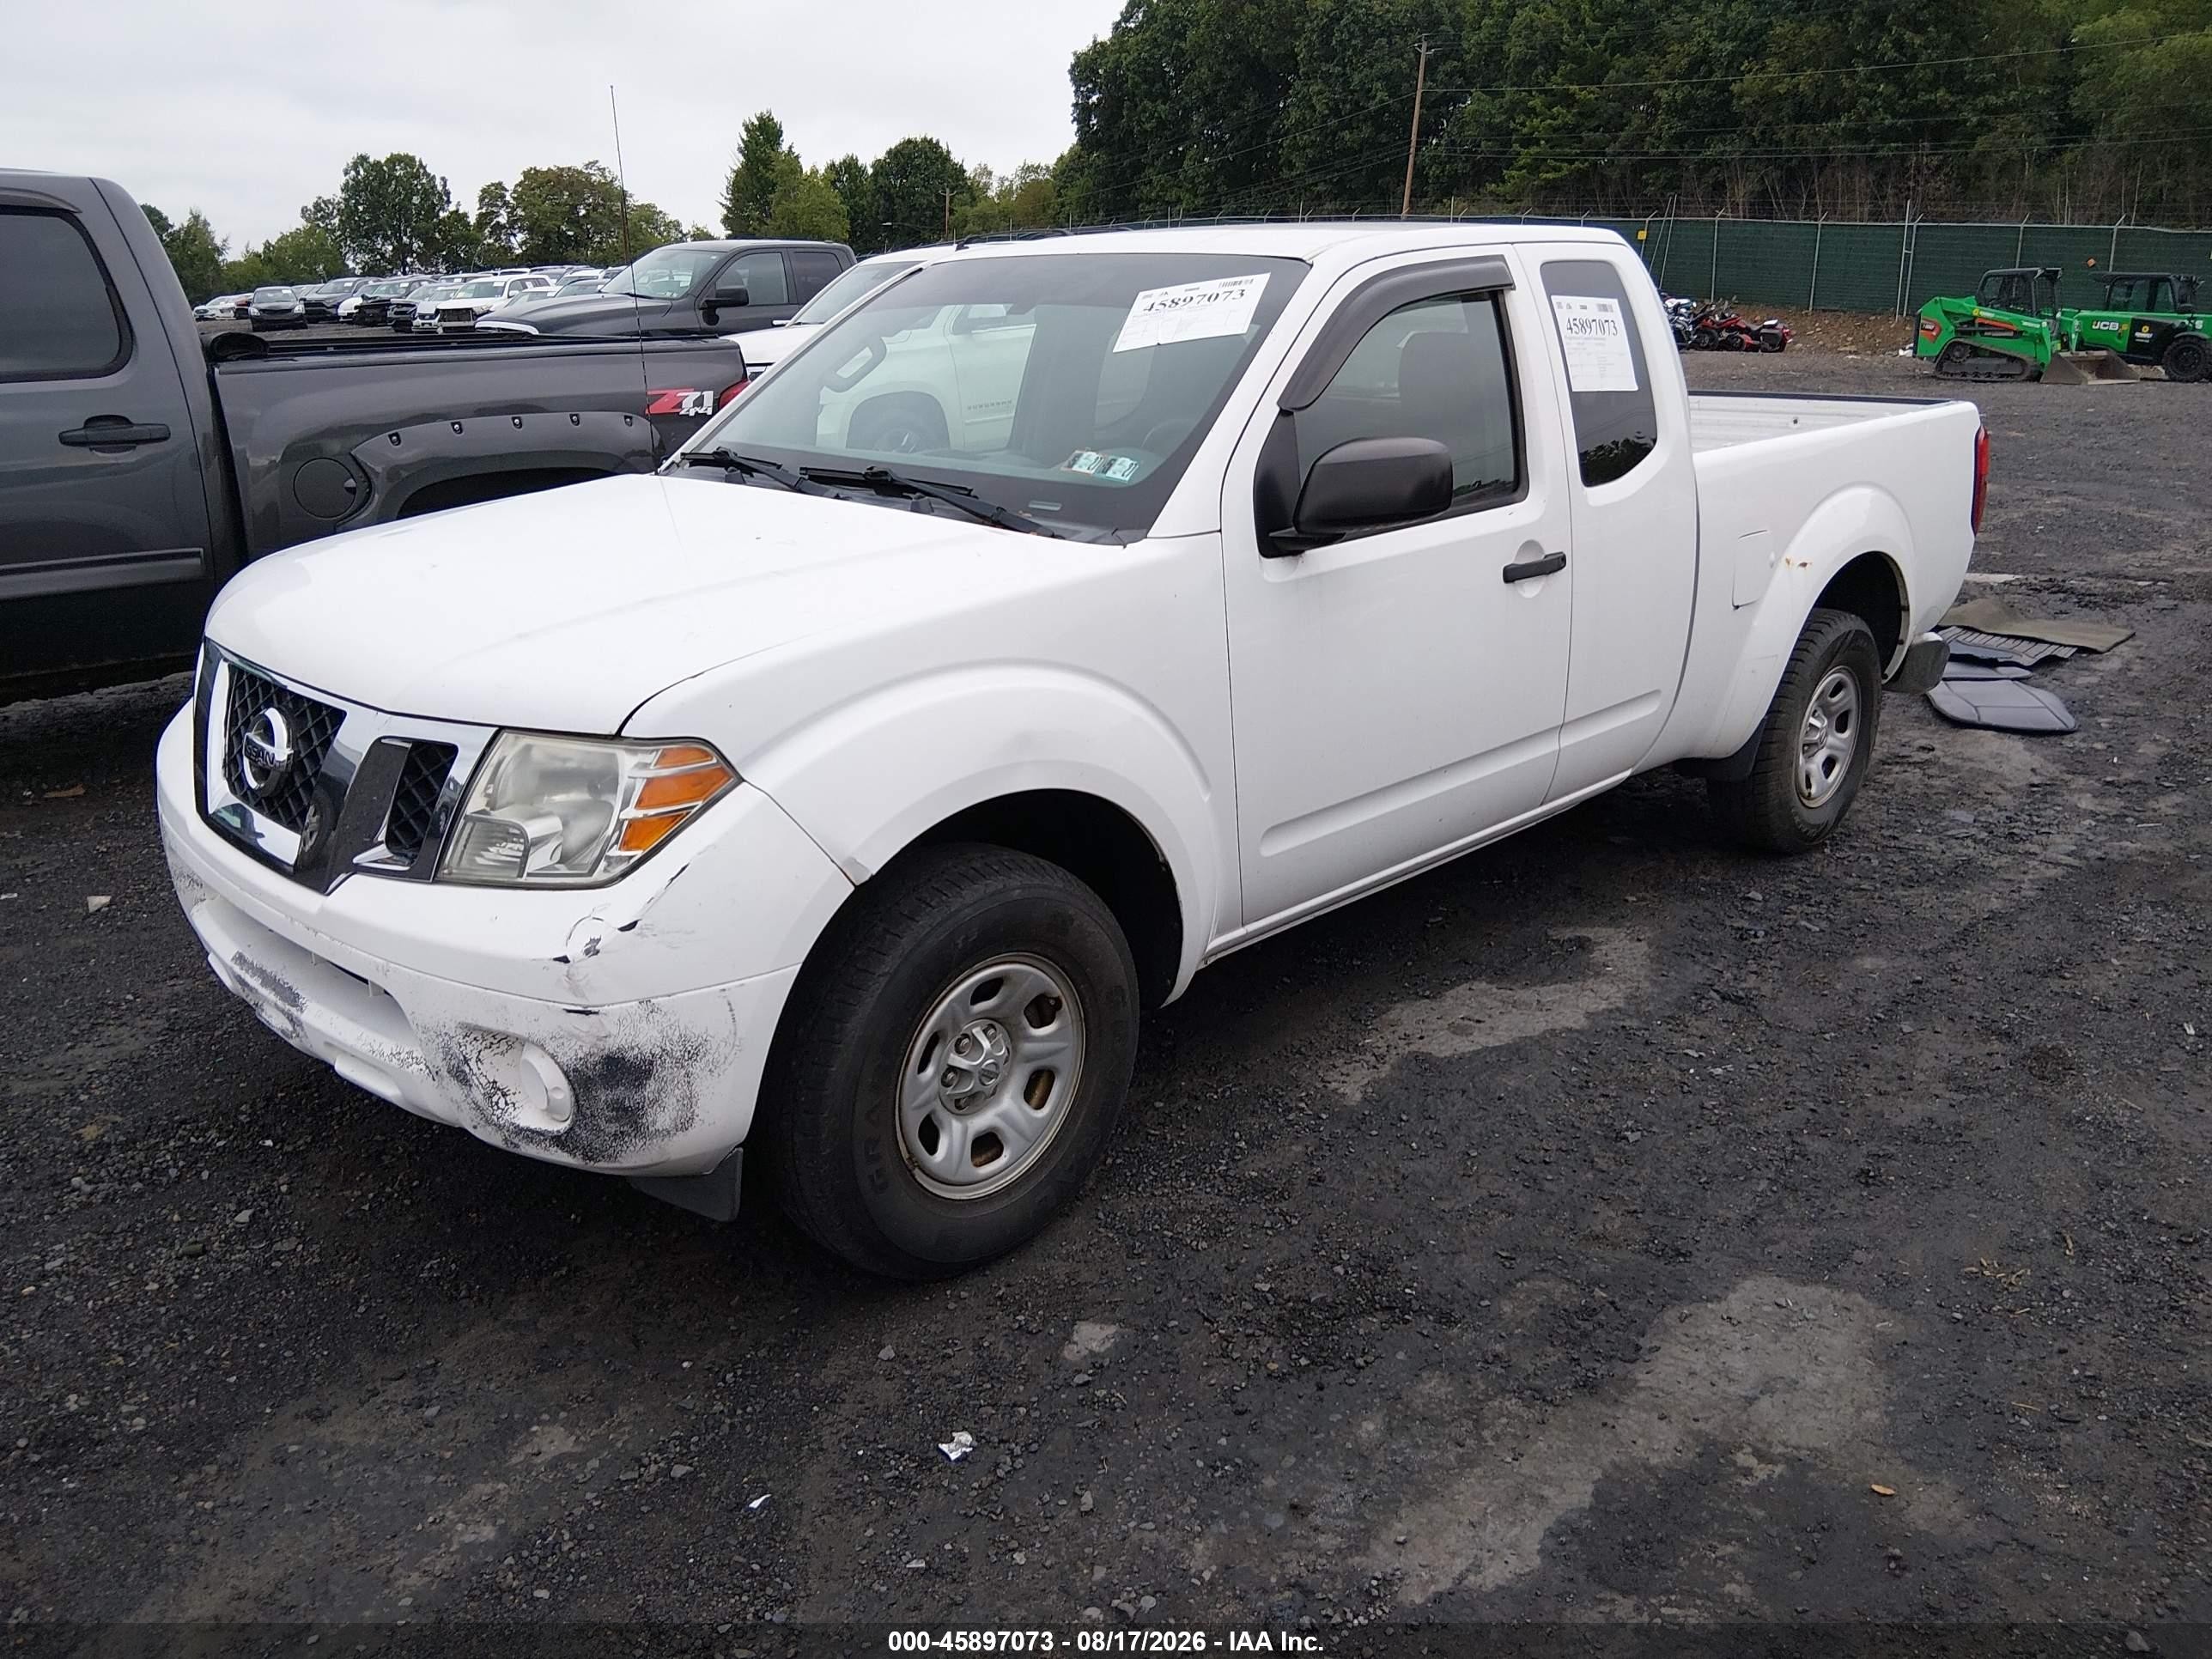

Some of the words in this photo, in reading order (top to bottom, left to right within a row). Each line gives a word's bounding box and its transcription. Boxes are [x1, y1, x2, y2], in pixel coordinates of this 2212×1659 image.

[1143, 289, 1245, 313] 45897073
[1566, 317, 1618, 337] 45897073
[2092, 320, 2119, 331] JCB
[646, 388, 714, 414] Z71
